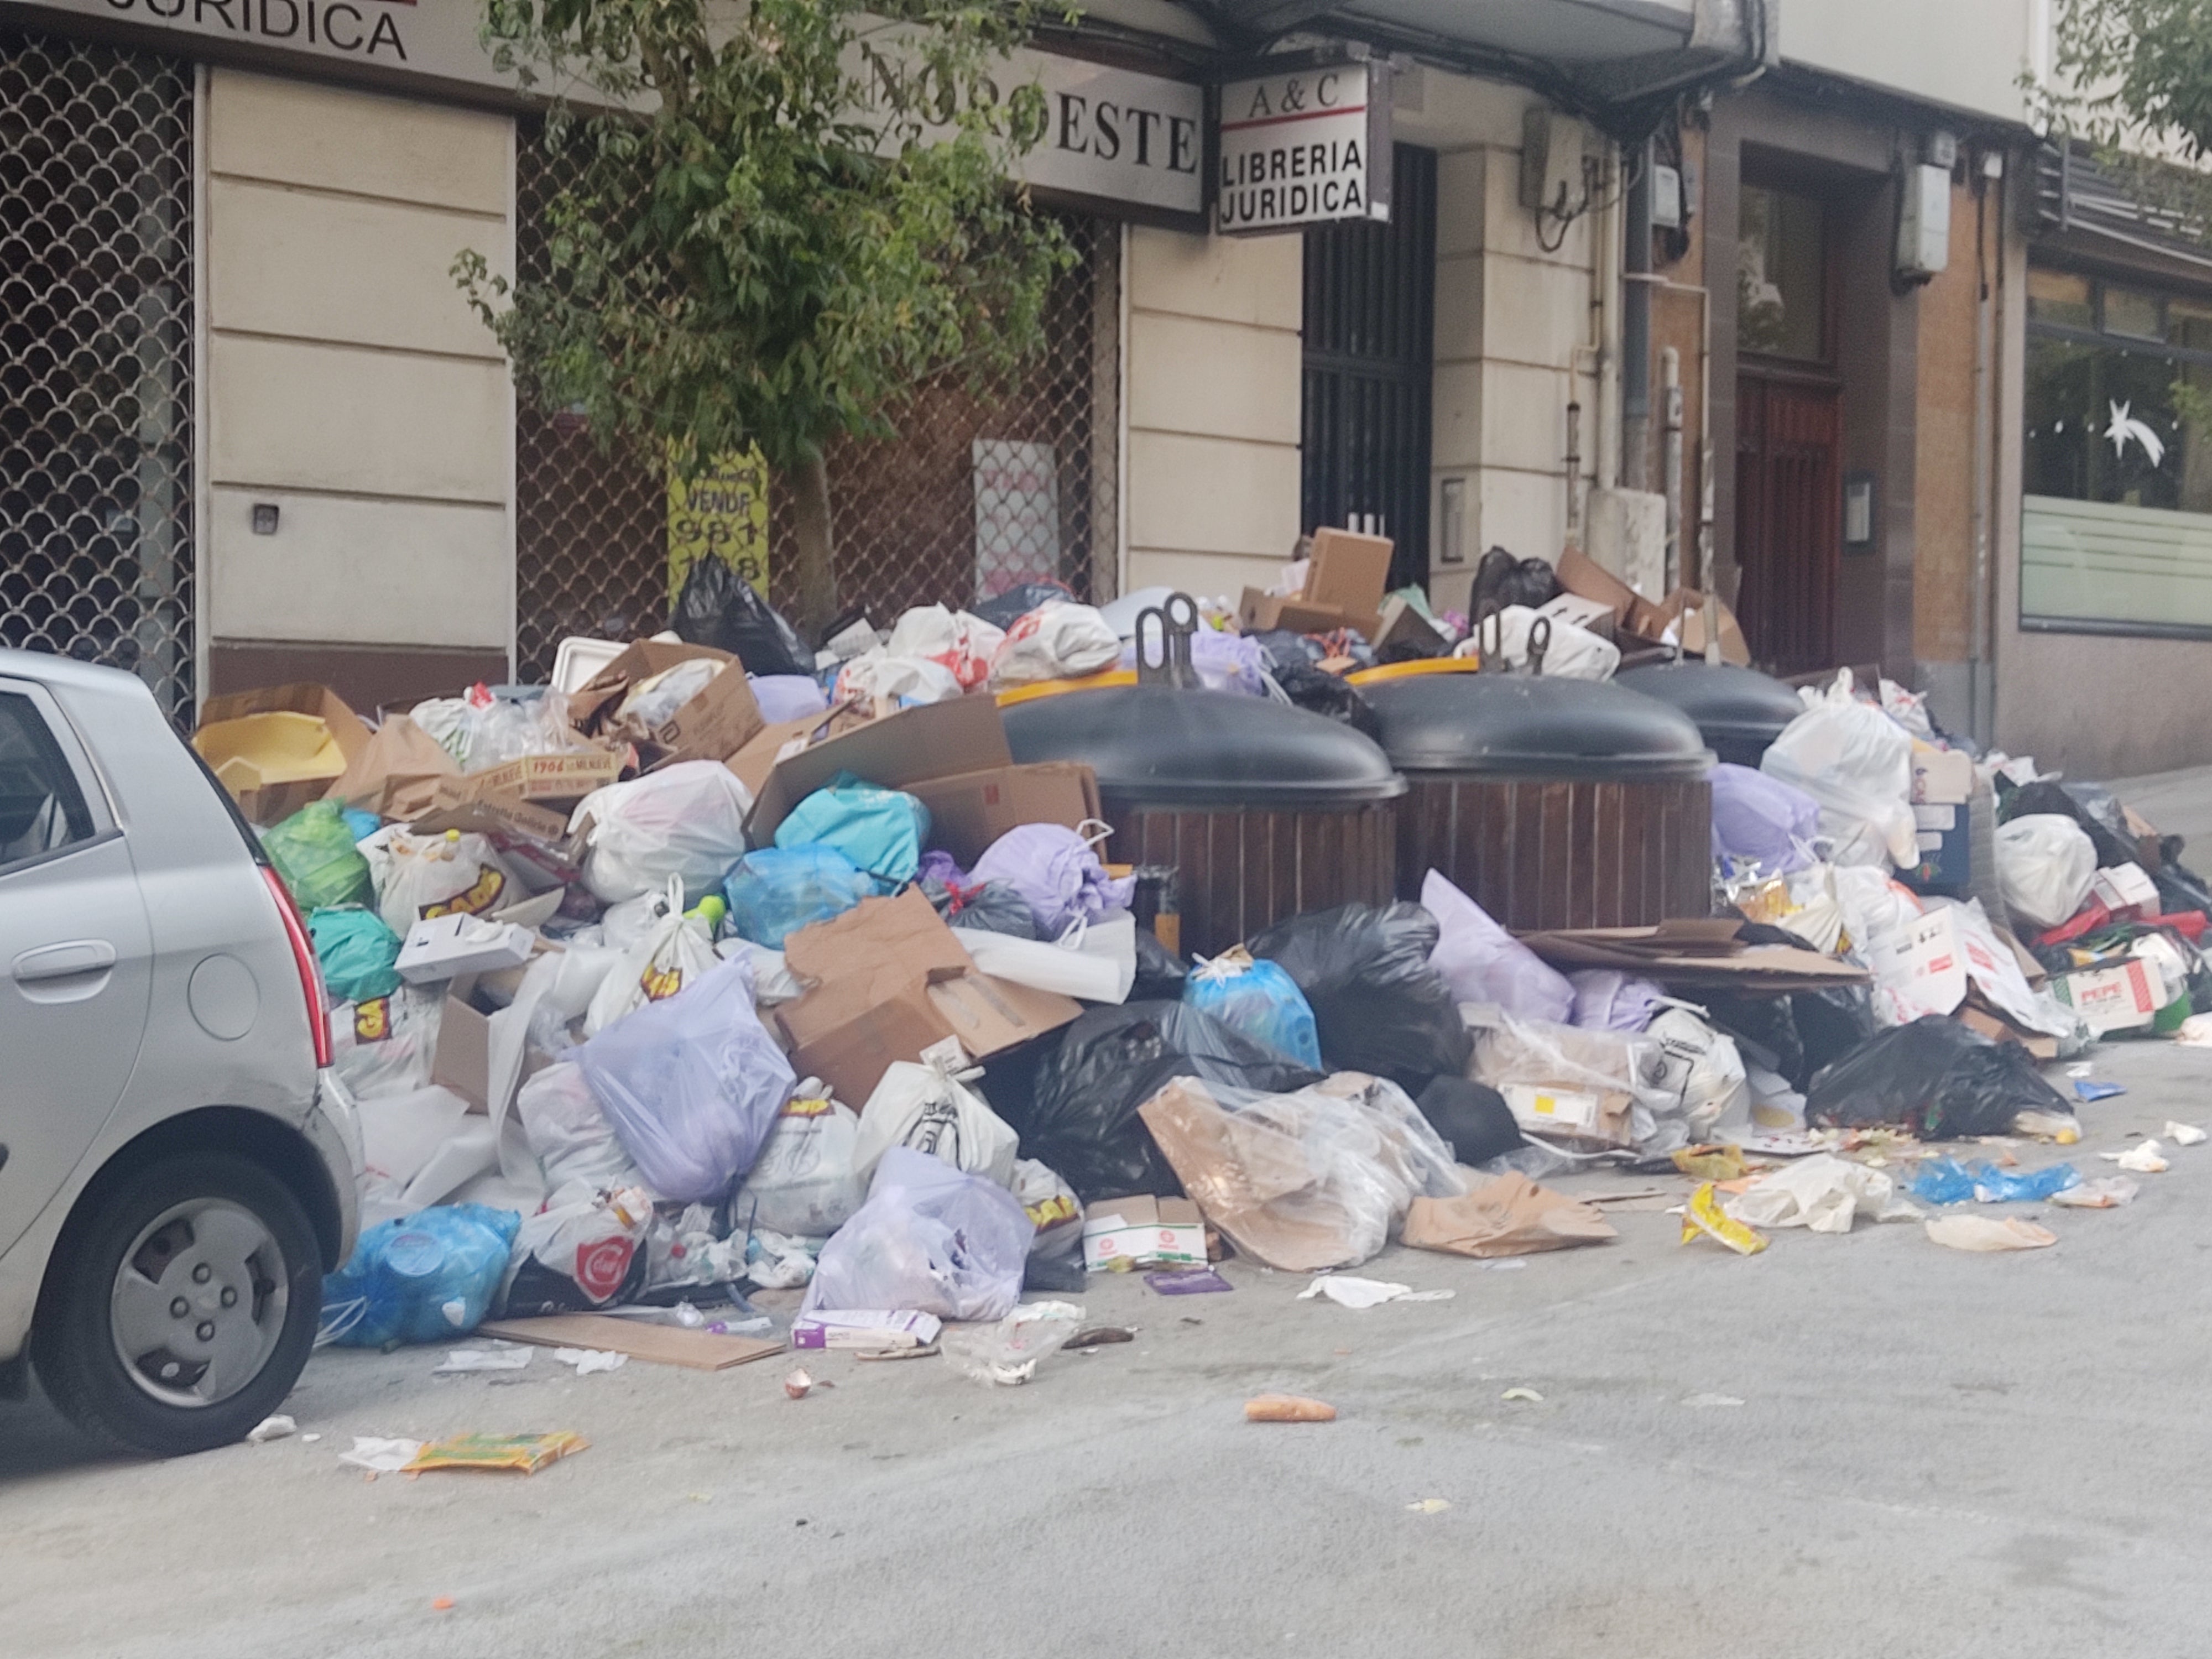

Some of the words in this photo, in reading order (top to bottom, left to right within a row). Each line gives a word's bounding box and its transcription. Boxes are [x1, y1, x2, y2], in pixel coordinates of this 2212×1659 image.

[1248, 85, 1272, 118] A
[1280, 79, 1307, 112] &
[1317, 73, 1339, 107] C
[1222, 139, 1362, 187] LIBRERIA
[1221, 179, 1362, 223] JURIDICA
